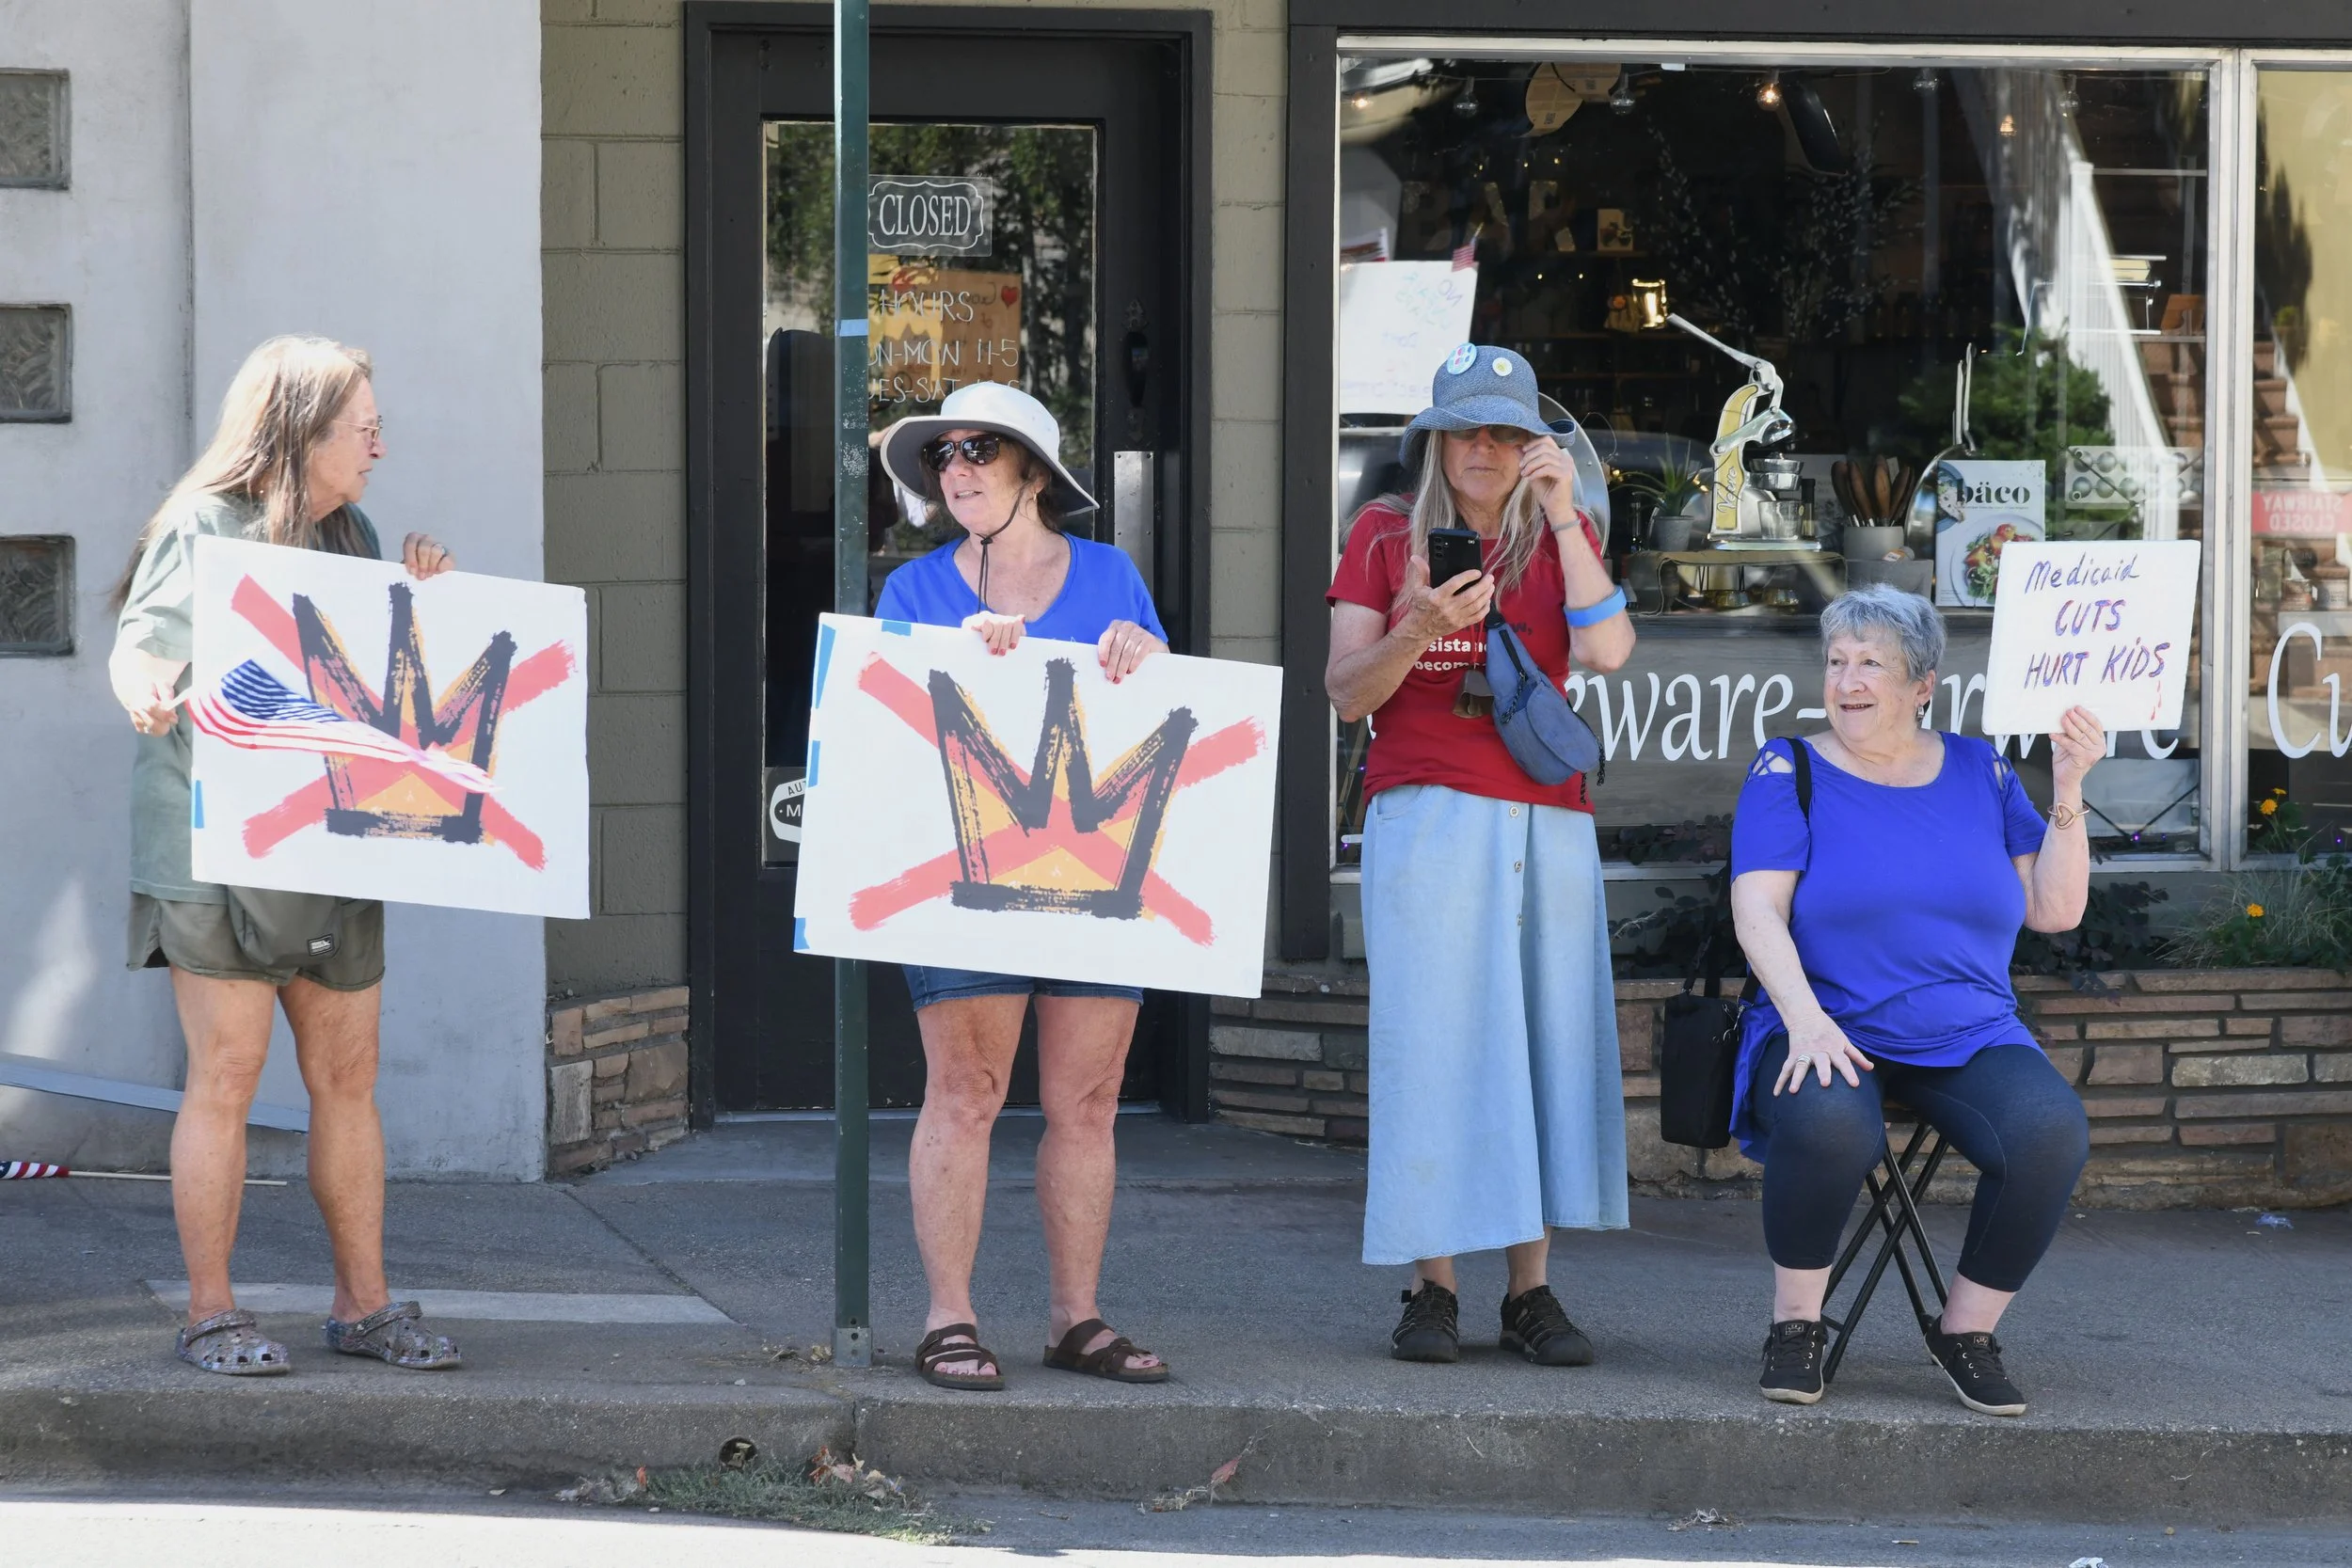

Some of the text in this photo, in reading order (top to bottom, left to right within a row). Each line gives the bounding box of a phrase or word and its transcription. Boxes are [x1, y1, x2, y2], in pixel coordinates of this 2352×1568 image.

[879, 194, 972, 236] CLOSED
[881, 289, 974, 322] HOURS
[977, 339, 1019, 367] 11-5
[1957, 482, 2030, 504] bäco
[2025, 552, 2139, 594] Medicaid
[2055, 599, 2125, 636] CUTS
[2025, 651, 2090, 689] HURT
[787, 780, 806, 796] AU
